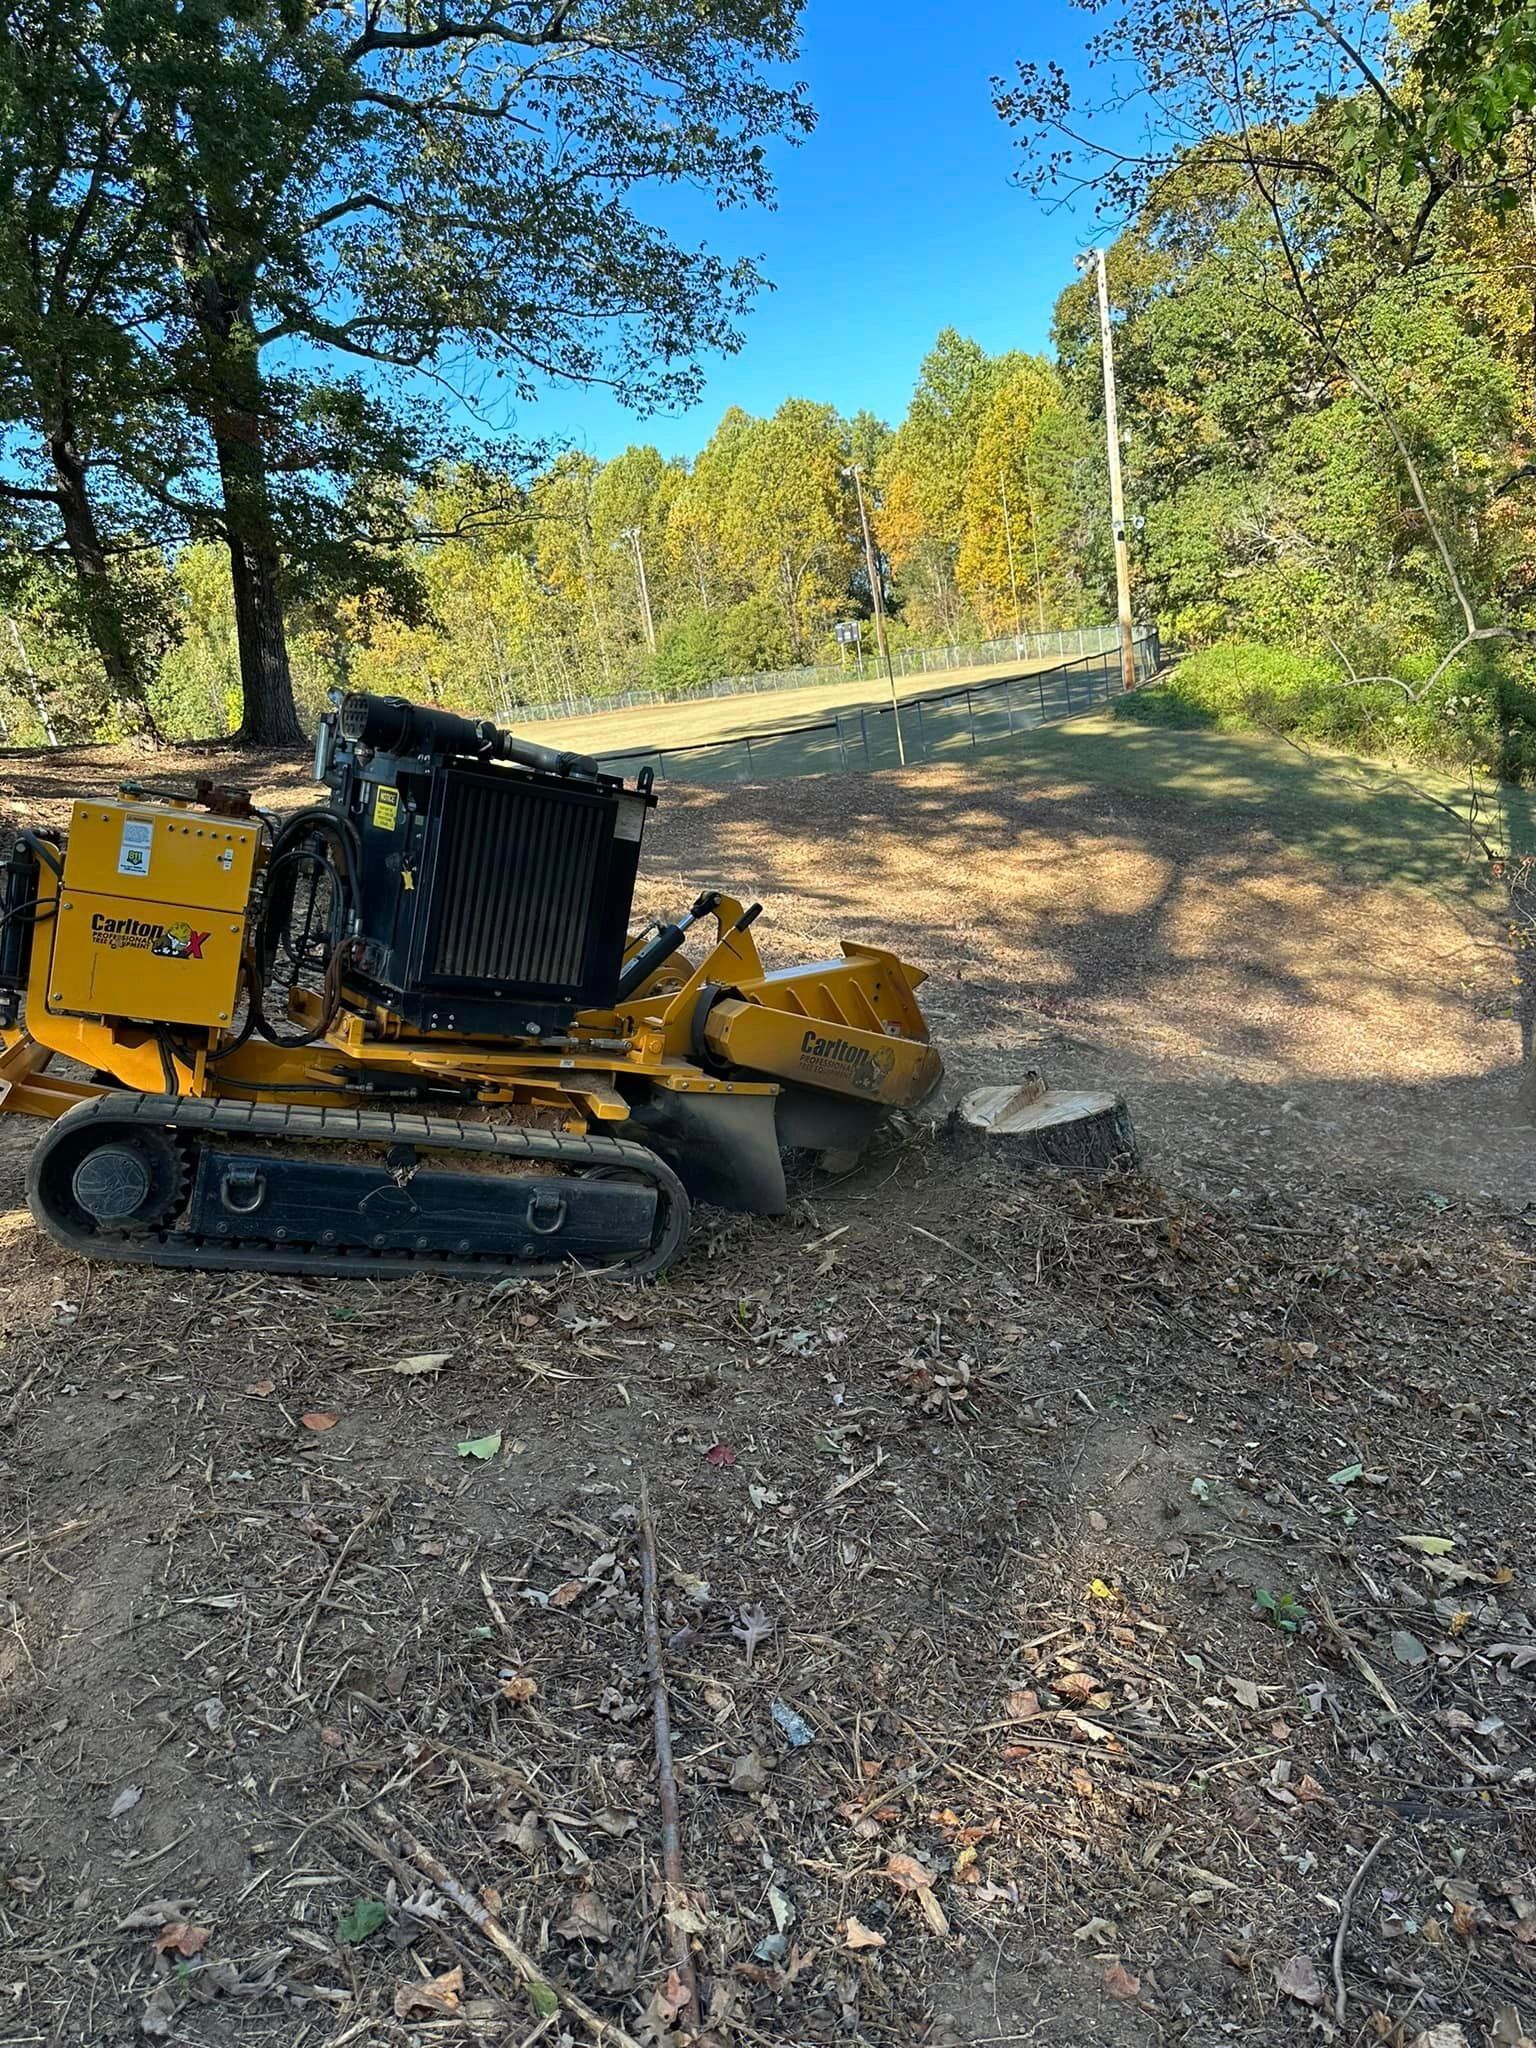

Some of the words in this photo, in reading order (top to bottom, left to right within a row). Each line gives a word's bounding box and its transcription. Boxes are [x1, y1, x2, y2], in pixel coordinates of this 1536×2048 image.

[92, 914, 163, 938] Carlton
[92, 931, 153, 944] PROFESIONAL
[801, 1031, 869, 1065] Carlton
